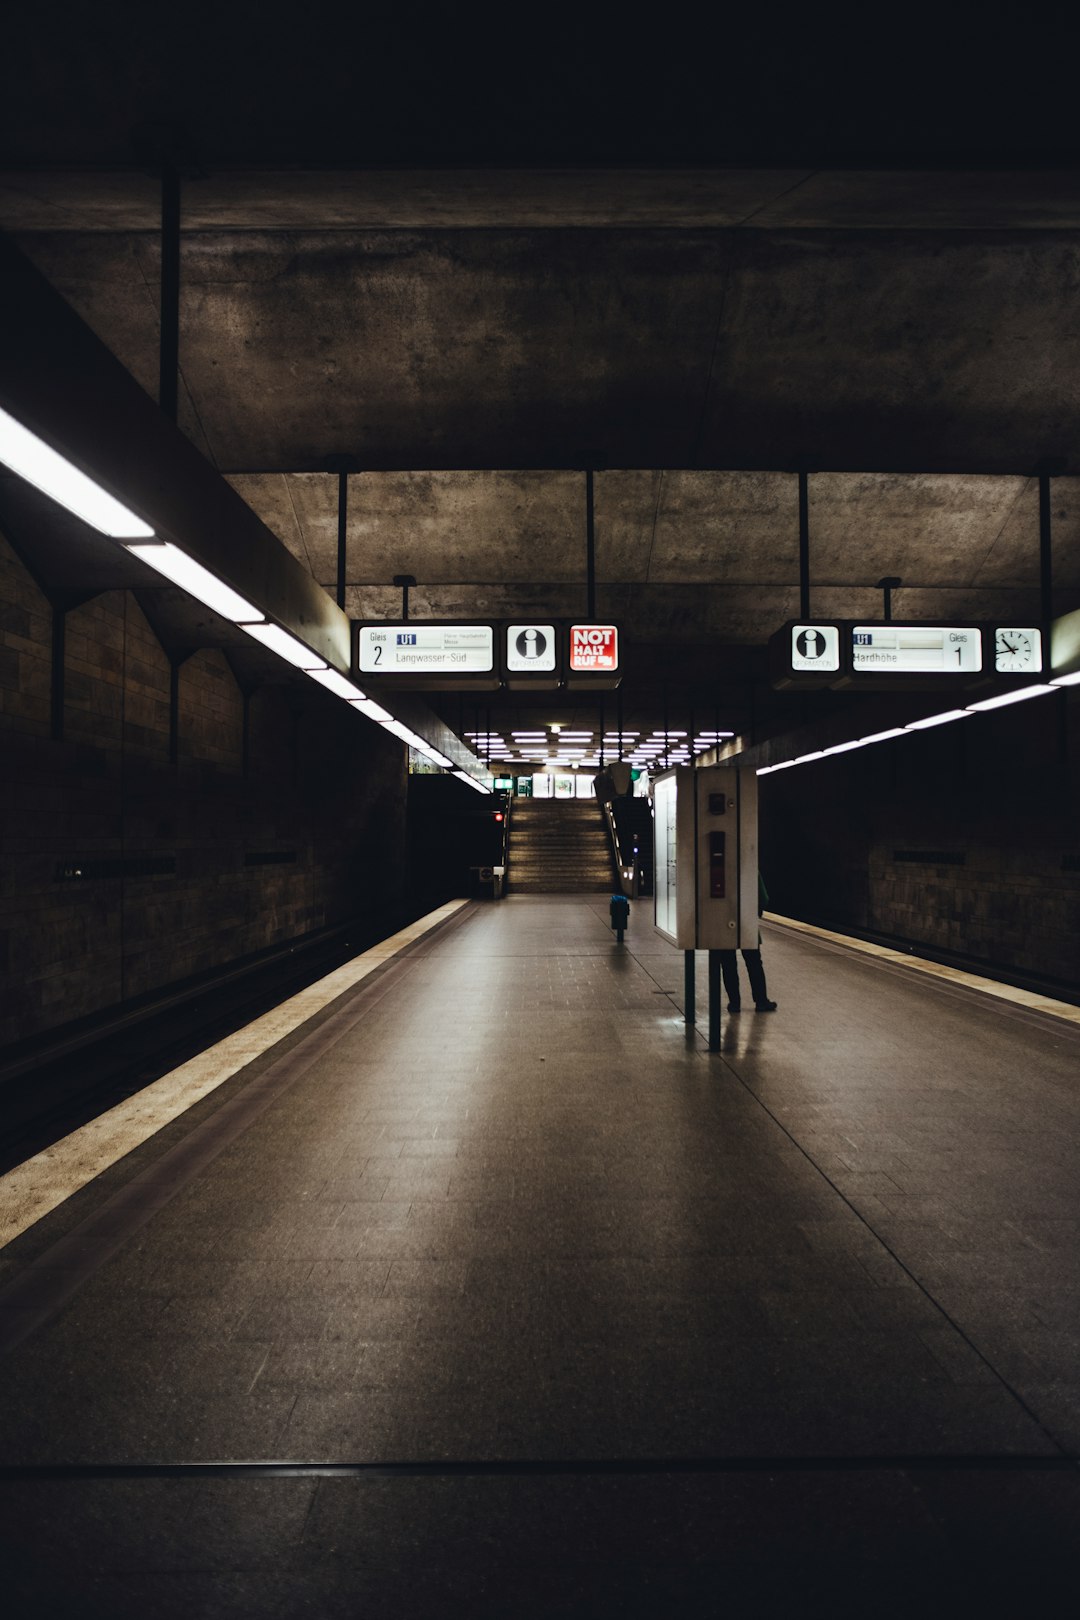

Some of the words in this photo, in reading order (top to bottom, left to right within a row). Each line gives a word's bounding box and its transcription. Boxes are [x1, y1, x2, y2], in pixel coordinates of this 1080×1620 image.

[370, 632, 387, 641] Gleis
[401, 634, 412, 644] U1
[574, 630, 612, 645] NOT
[857, 634, 868, 644] U1
[949, 633, 968, 642] Gleis
[373, 645, 383, 665] 2
[574, 645, 604, 656] HALT
[396, 652, 467, 665] Langwasser-Süd
[574, 656, 597, 666] RUF
[854, 652, 897, 662] Hardhöhe
[954, 646, 962, 666] 1
